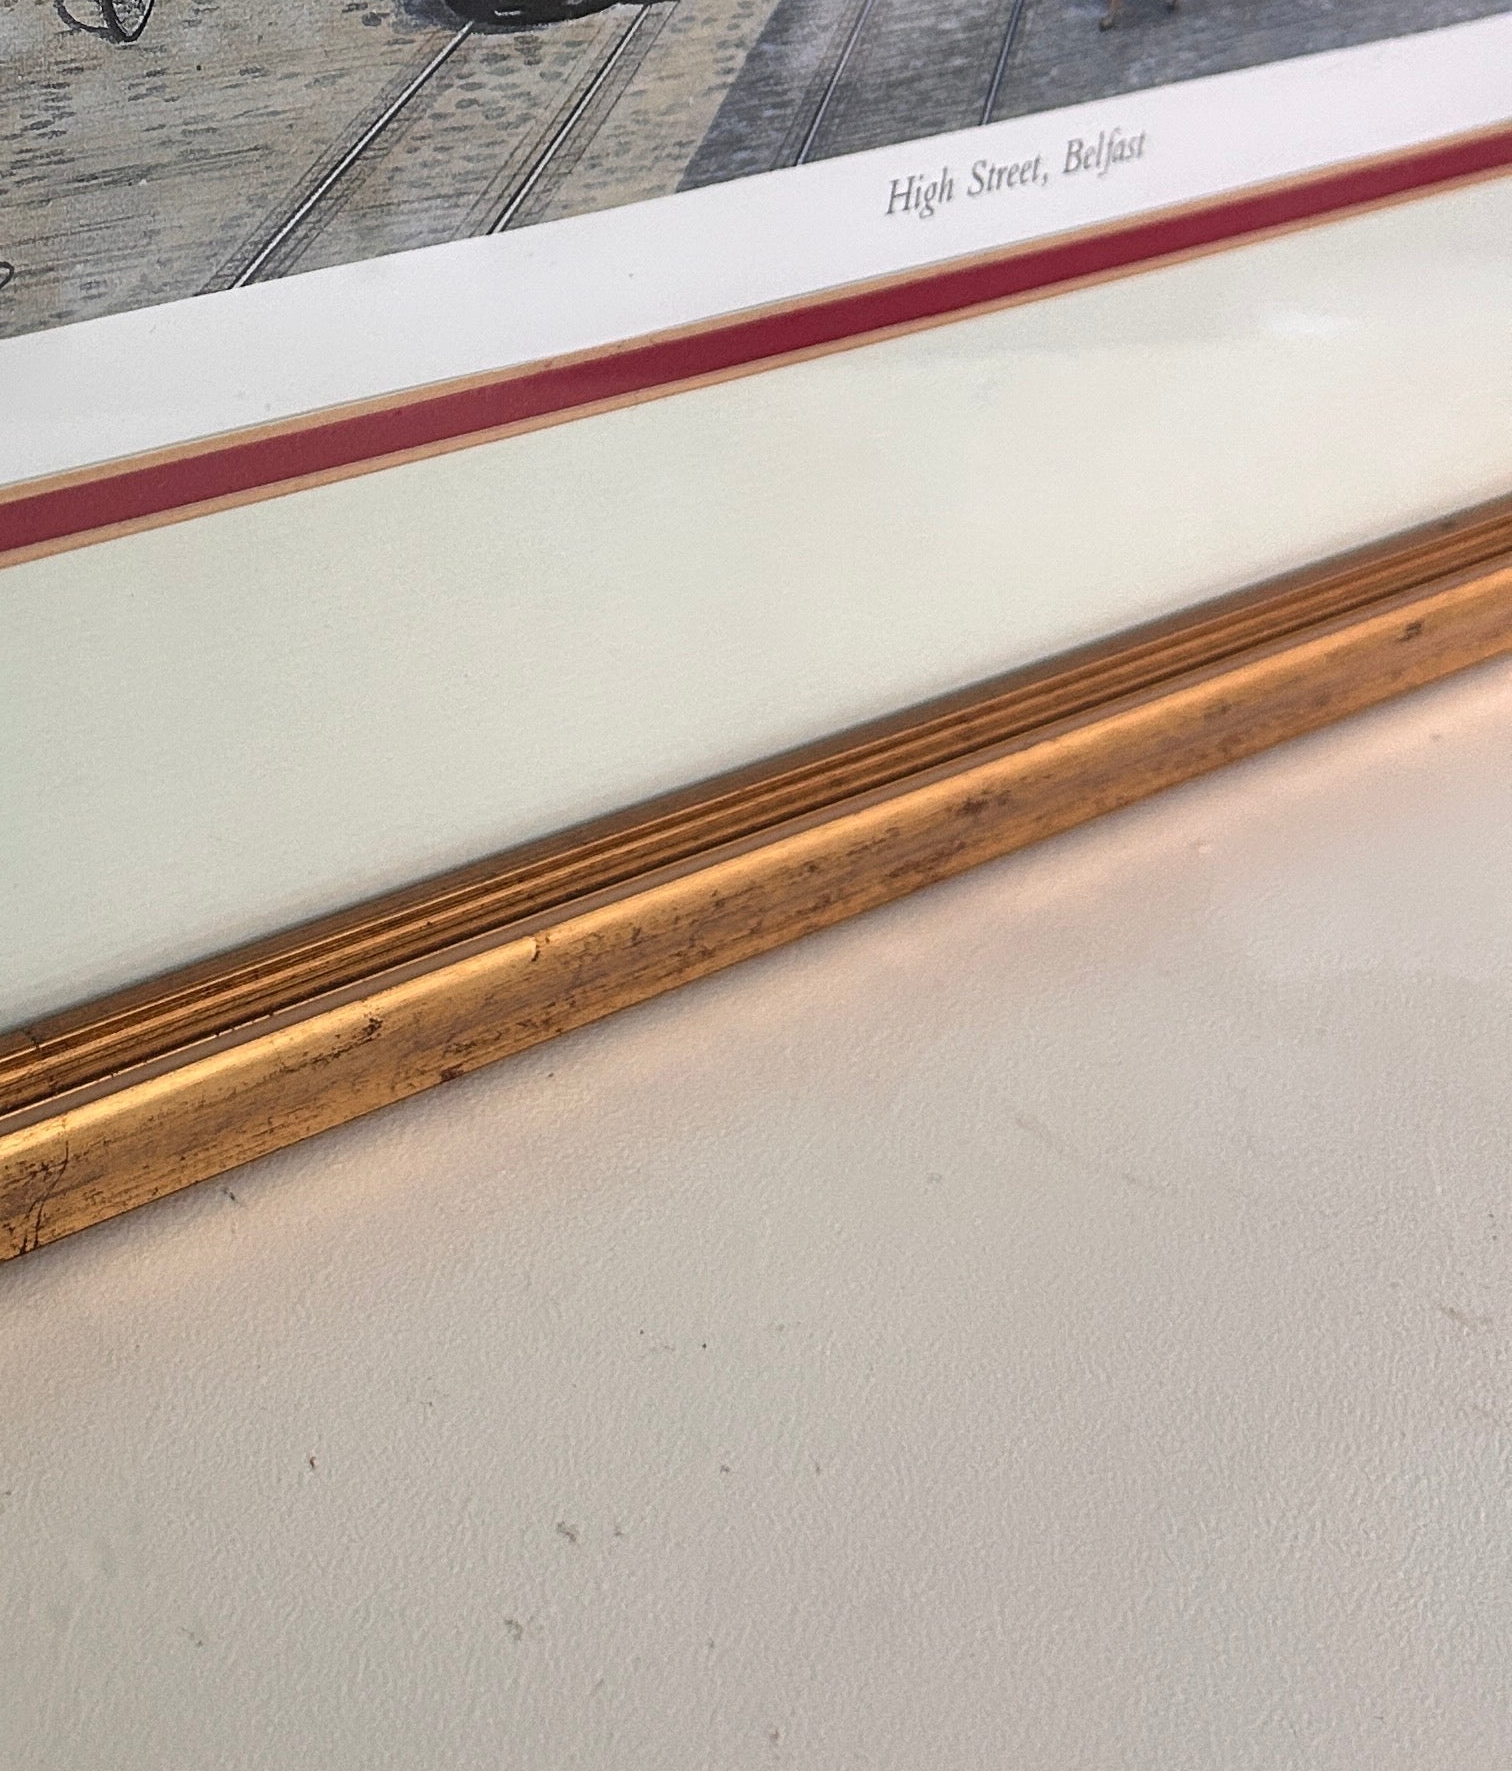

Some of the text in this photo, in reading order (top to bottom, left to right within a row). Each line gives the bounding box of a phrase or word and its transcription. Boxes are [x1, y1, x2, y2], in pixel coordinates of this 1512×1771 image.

[886, 127, 1147, 219] High Street, Belfast
